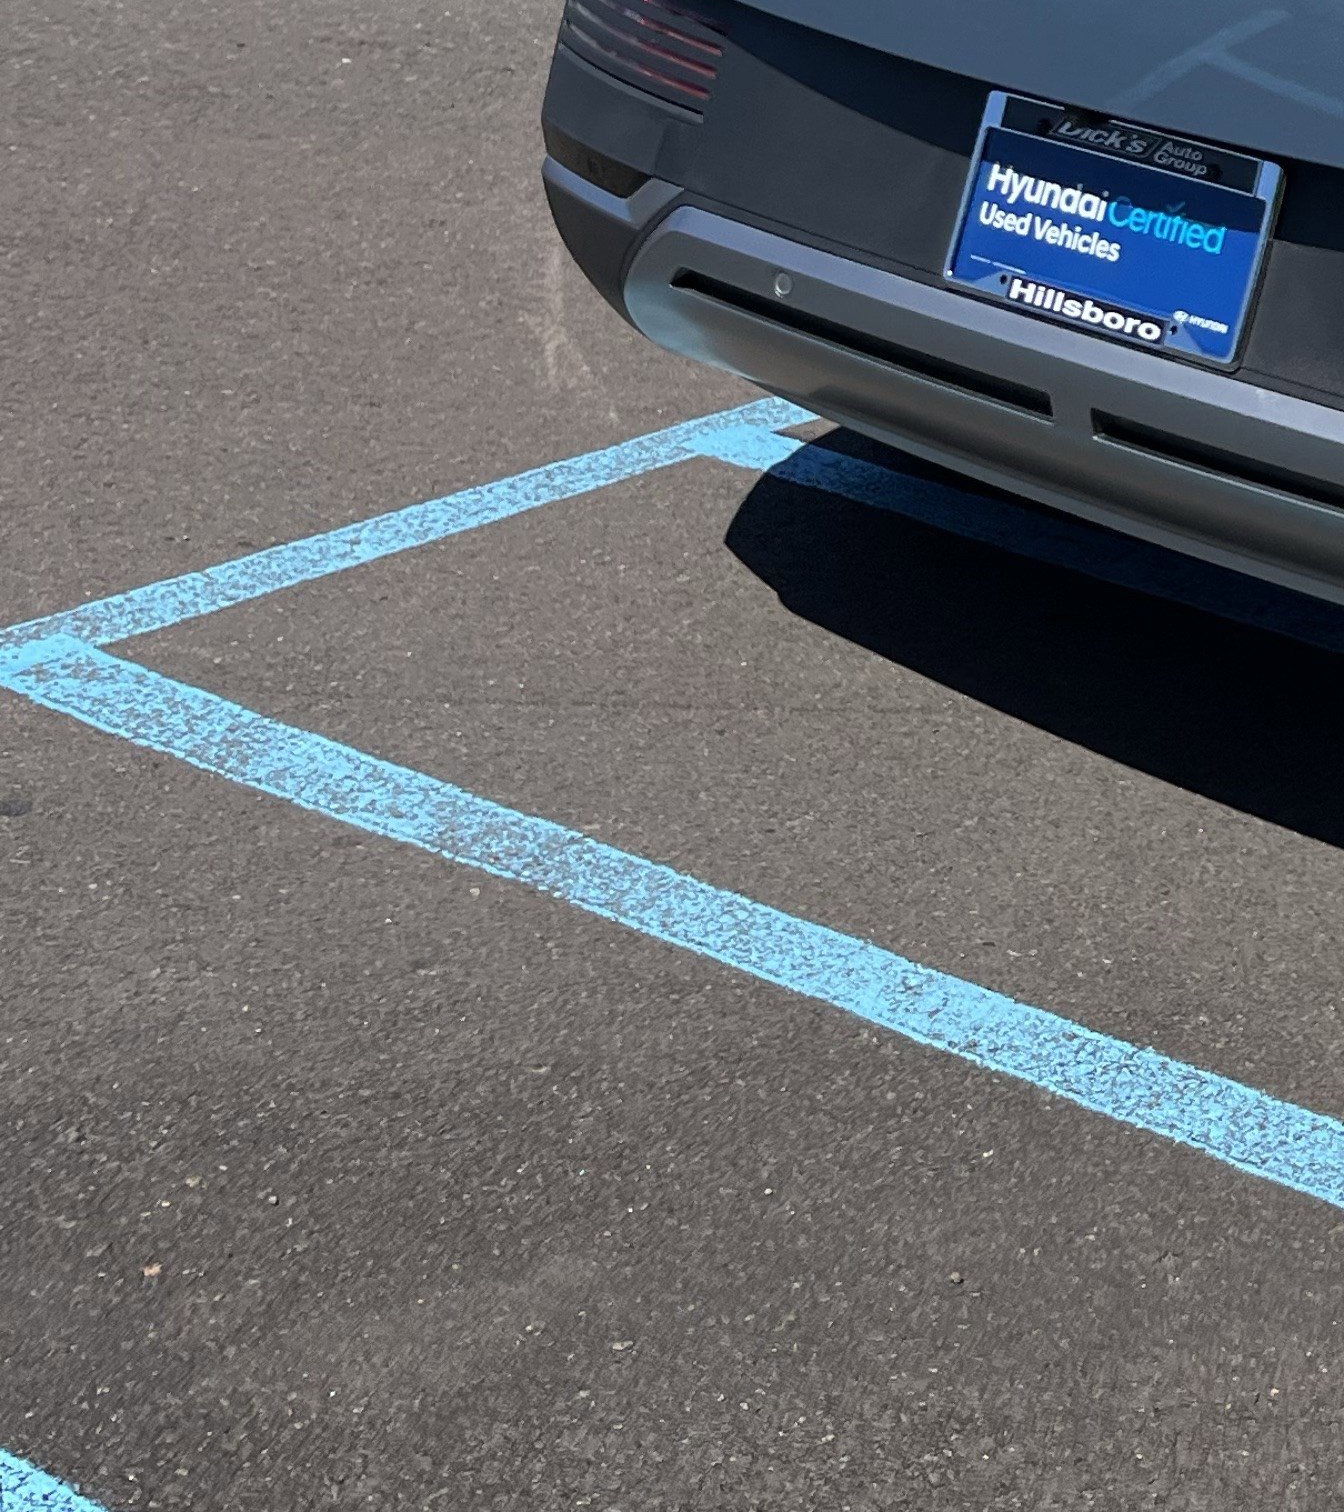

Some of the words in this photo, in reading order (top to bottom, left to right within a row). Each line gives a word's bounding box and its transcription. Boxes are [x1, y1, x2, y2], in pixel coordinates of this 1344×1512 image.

[1153, 151, 1208, 177] Group
[1161, 141, 1203, 162] Auto
[979, 200, 1032, 237] Used
[1032, 212, 1121, 263] Vehicles
[986, 163, 1110, 223] Hyundai
[1107, 196, 1227, 255] Certified
[1008, 277, 1162, 341] Hillsboro
